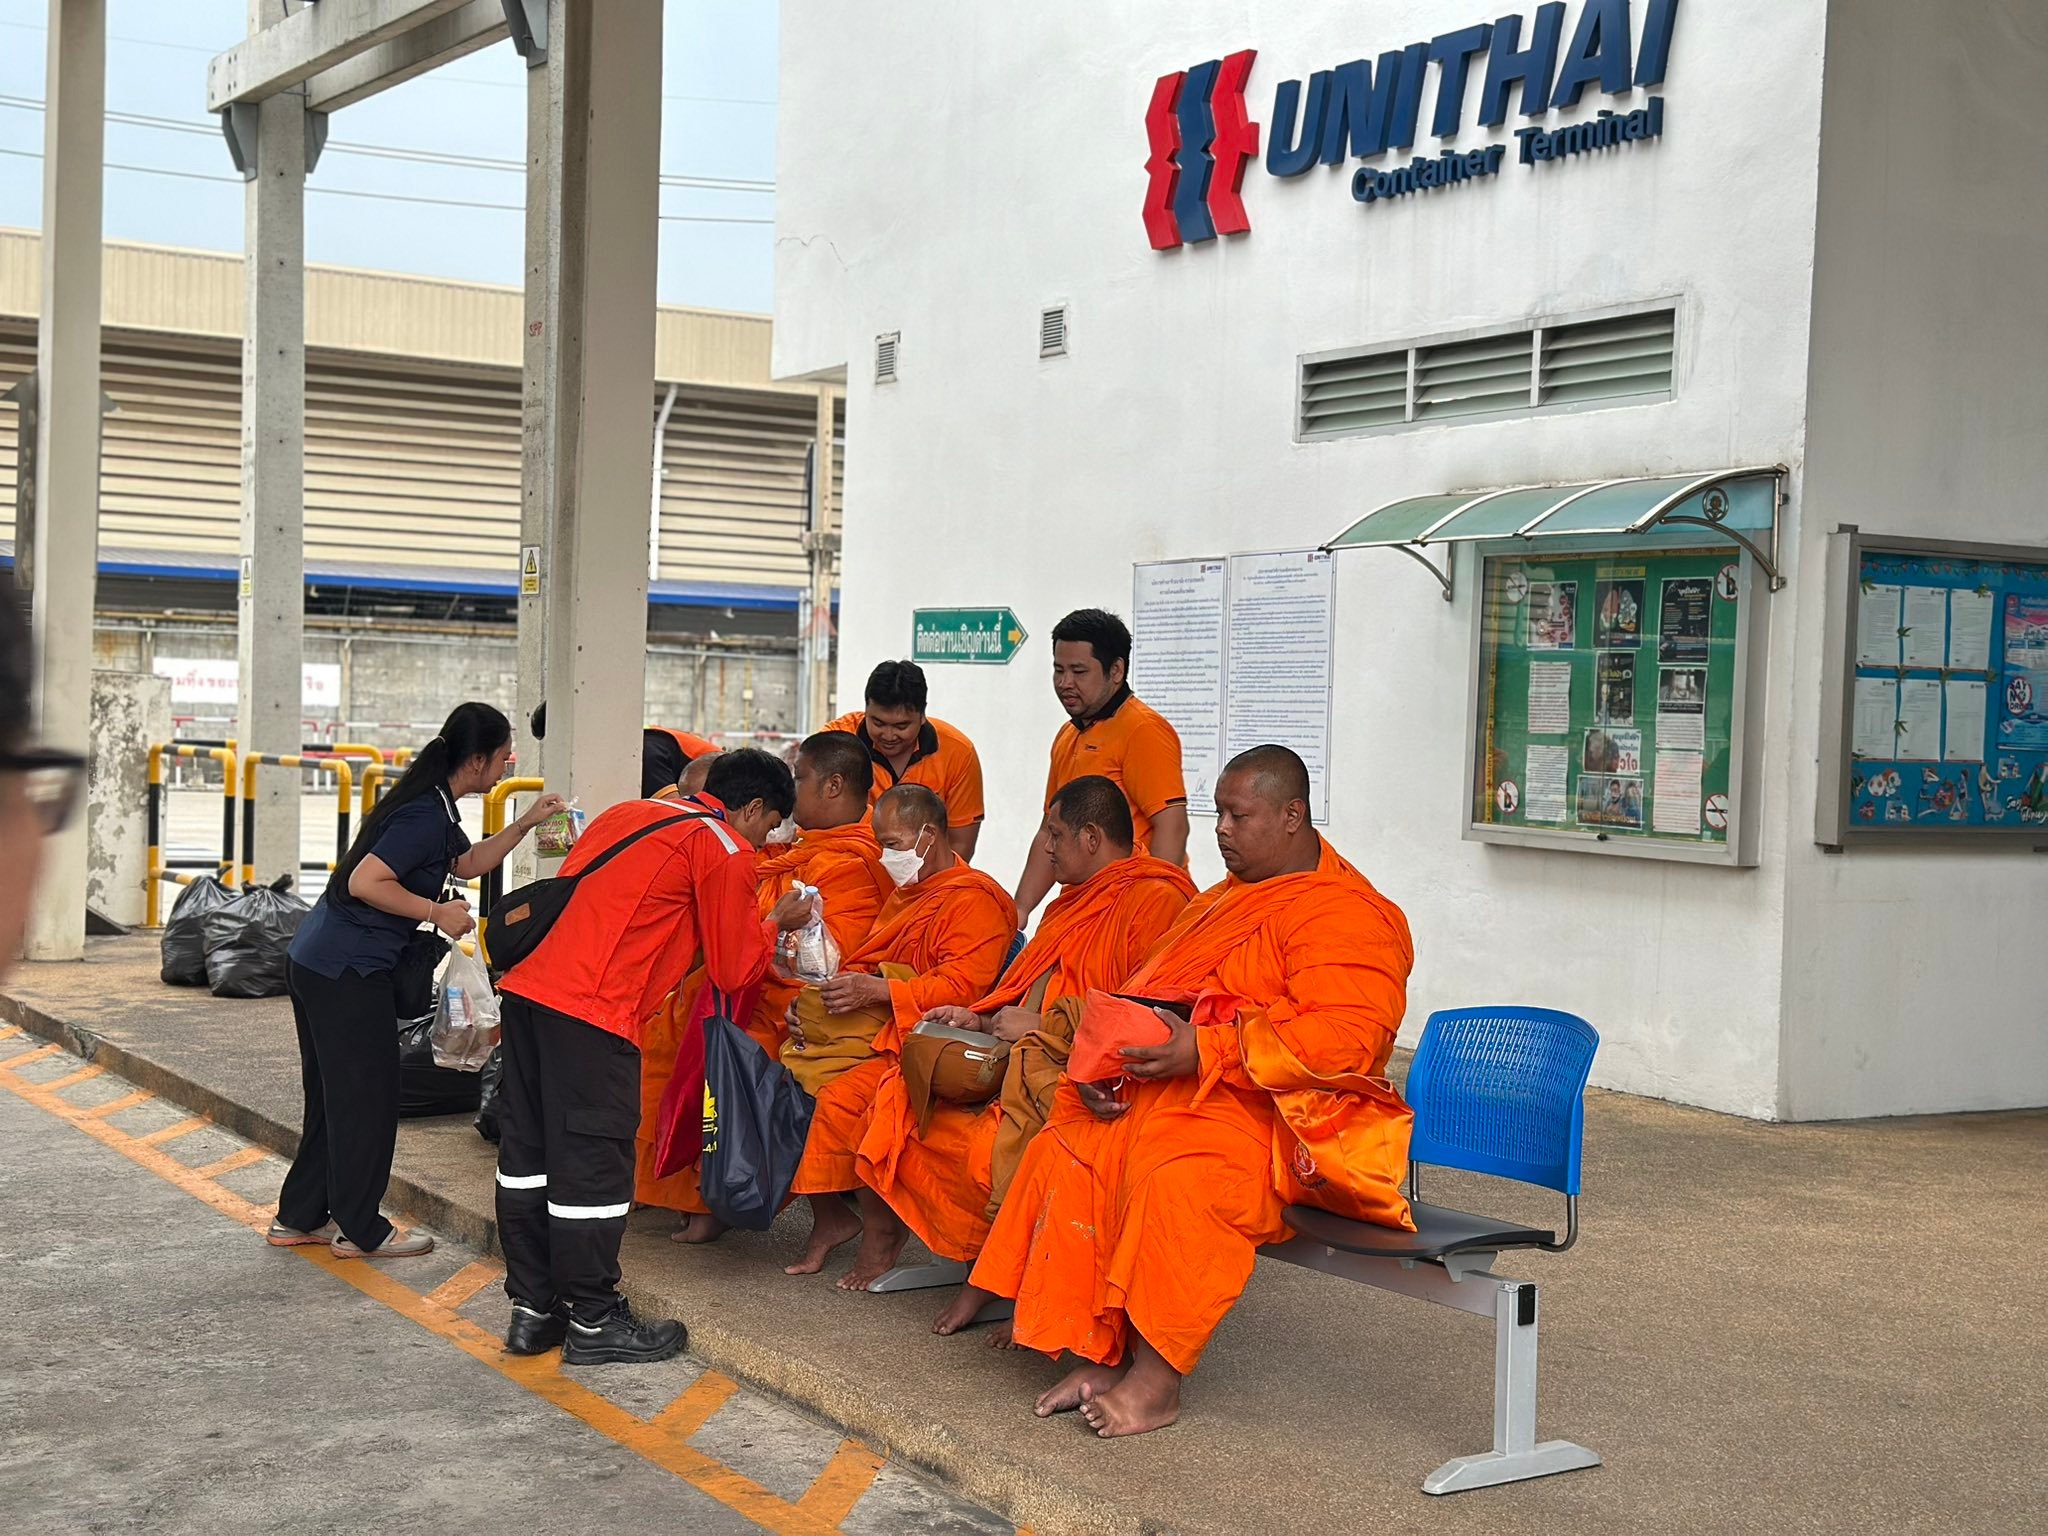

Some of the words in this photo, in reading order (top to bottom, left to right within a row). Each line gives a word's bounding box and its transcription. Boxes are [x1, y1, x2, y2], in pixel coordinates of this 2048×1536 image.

[1266, 0, 1677, 178] UNITHAI
[1352, 144, 1506, 203] Container
[1514, 96, 1664, 165] Terminal
